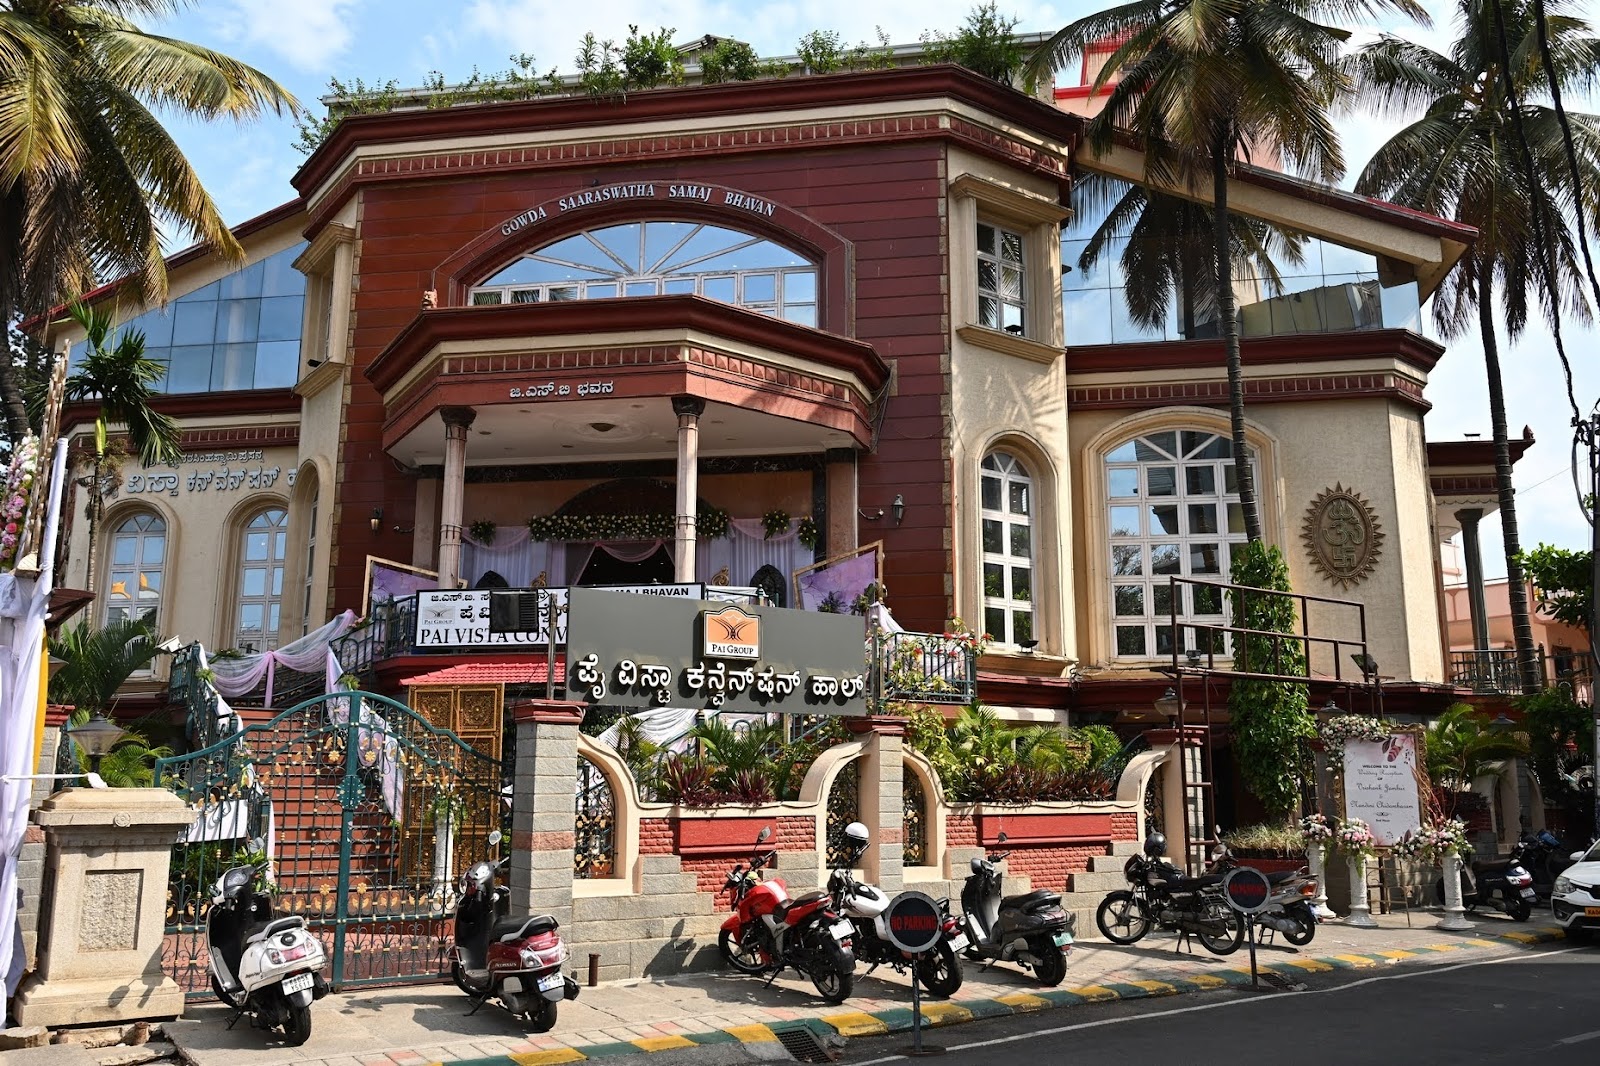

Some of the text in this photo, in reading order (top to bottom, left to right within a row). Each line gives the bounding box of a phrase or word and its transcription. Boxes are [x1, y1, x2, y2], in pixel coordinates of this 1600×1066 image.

[501, 184, 776, 236] GOWDA SAARASWATHA SAMAJ BHAVAN
[577, 380, 614, 396] ಭವನ
[420, 628, 450, 644] PAI
[712, 644, 754, 655] PAI GROUP
[578, 653, 606, 699] ಪೈ
[618, 659, 672, 703] ವಿಸ್ಟಾ
[812, 674, 864, 698] ಹಾಲ್
[891, 915, 936, 931] NO PARKING
